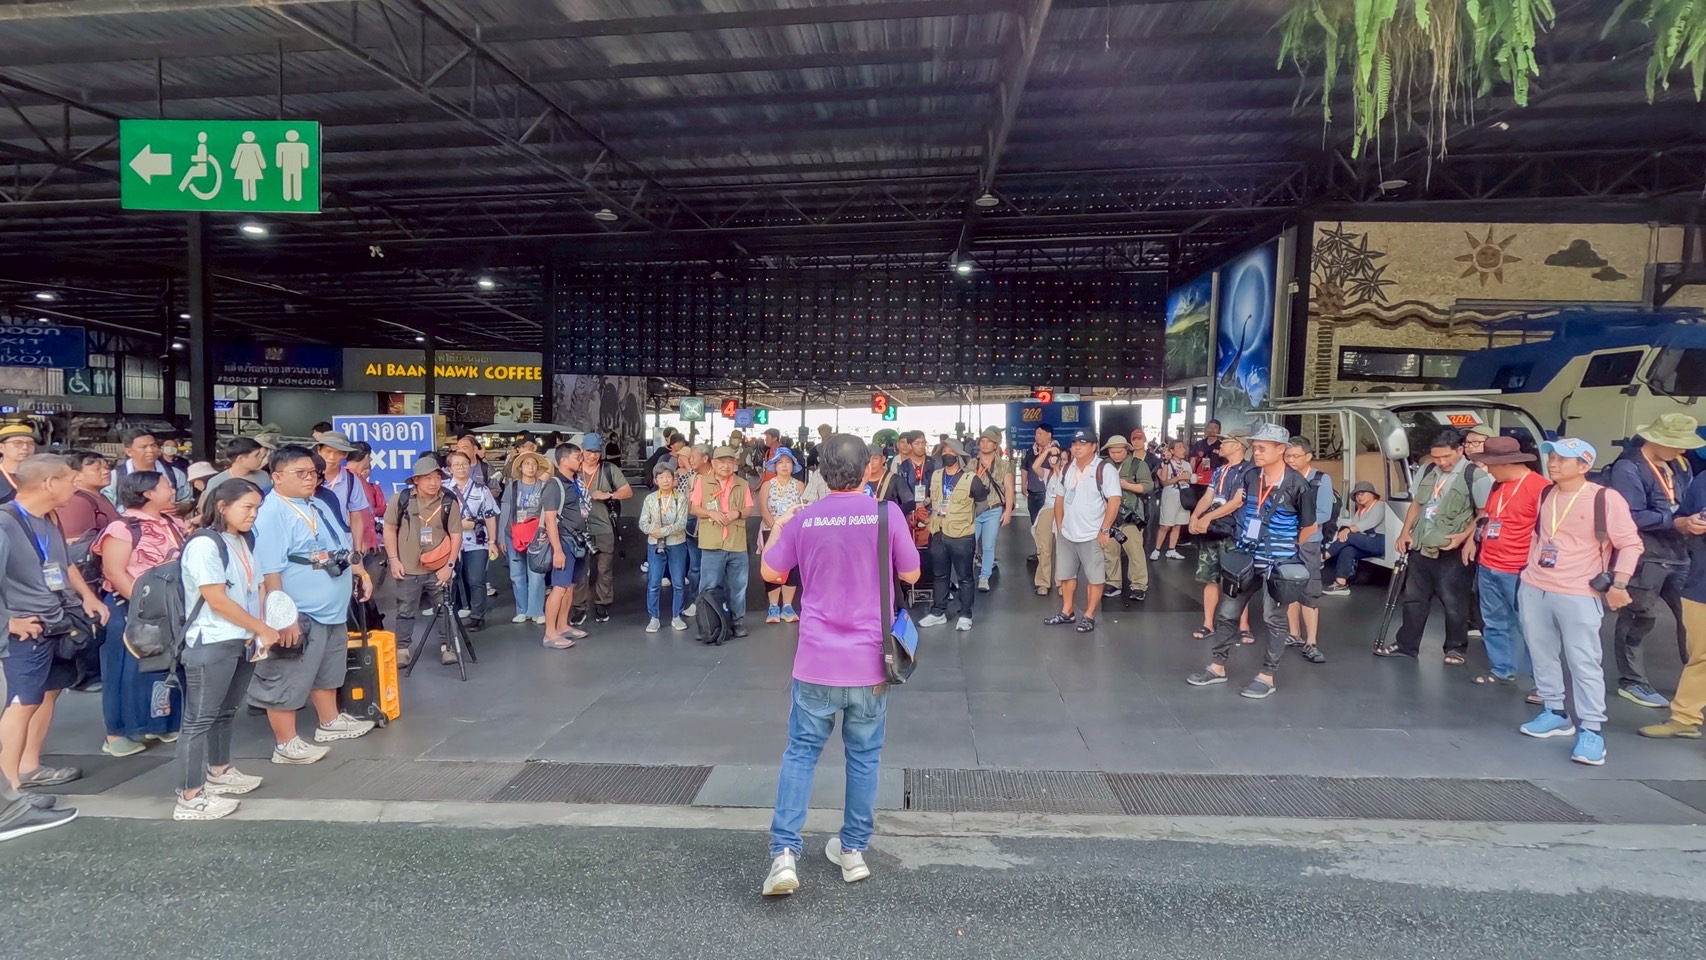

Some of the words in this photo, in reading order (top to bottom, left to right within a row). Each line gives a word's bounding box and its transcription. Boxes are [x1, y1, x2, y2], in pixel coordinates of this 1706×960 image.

[217, 376, 257, 384] PRODUCT
[366, 363, 382, 376] AI
[387, 364, 427, 377] BAAN
[434, 365, 479, 379] NAWK
[484, 366, 542, 380] COFFEE
[723, 400, 735, 417] 4
[875, 395, 887, 413] 3
[341, 421, 424, 442] ทางออก
[369, 448, 416, 470] XIT
[802, 518, 813, 528] AI
[813, 516, 847, 527] BAAN
[848, 514, 879, 526] NAW
